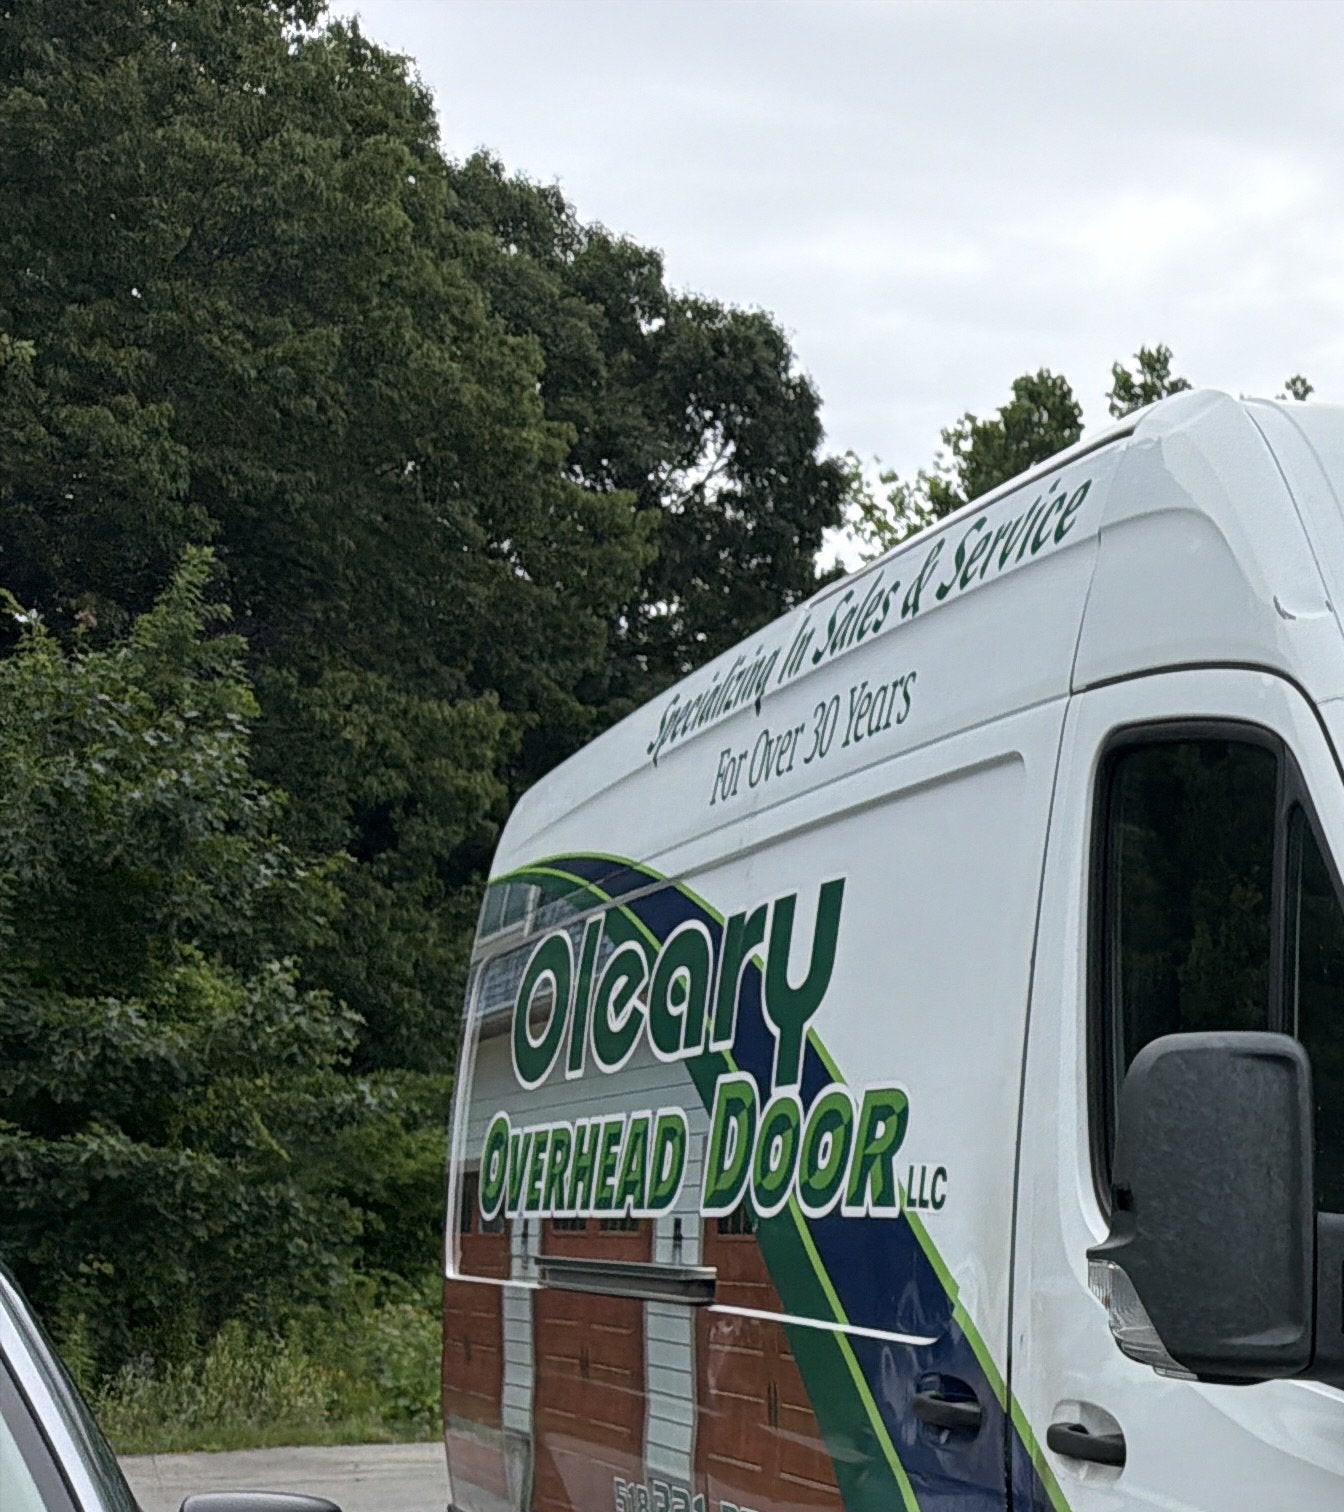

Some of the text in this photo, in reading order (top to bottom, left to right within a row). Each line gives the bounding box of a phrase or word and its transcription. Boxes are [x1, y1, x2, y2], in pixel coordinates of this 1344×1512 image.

[647, 479, 1092, 768] Specializing In Sales & Service
[710, 671, 916, 805] For Over 30 Years
[480, 1071, 948, 1220] OVERHEAD DOOR LLC
